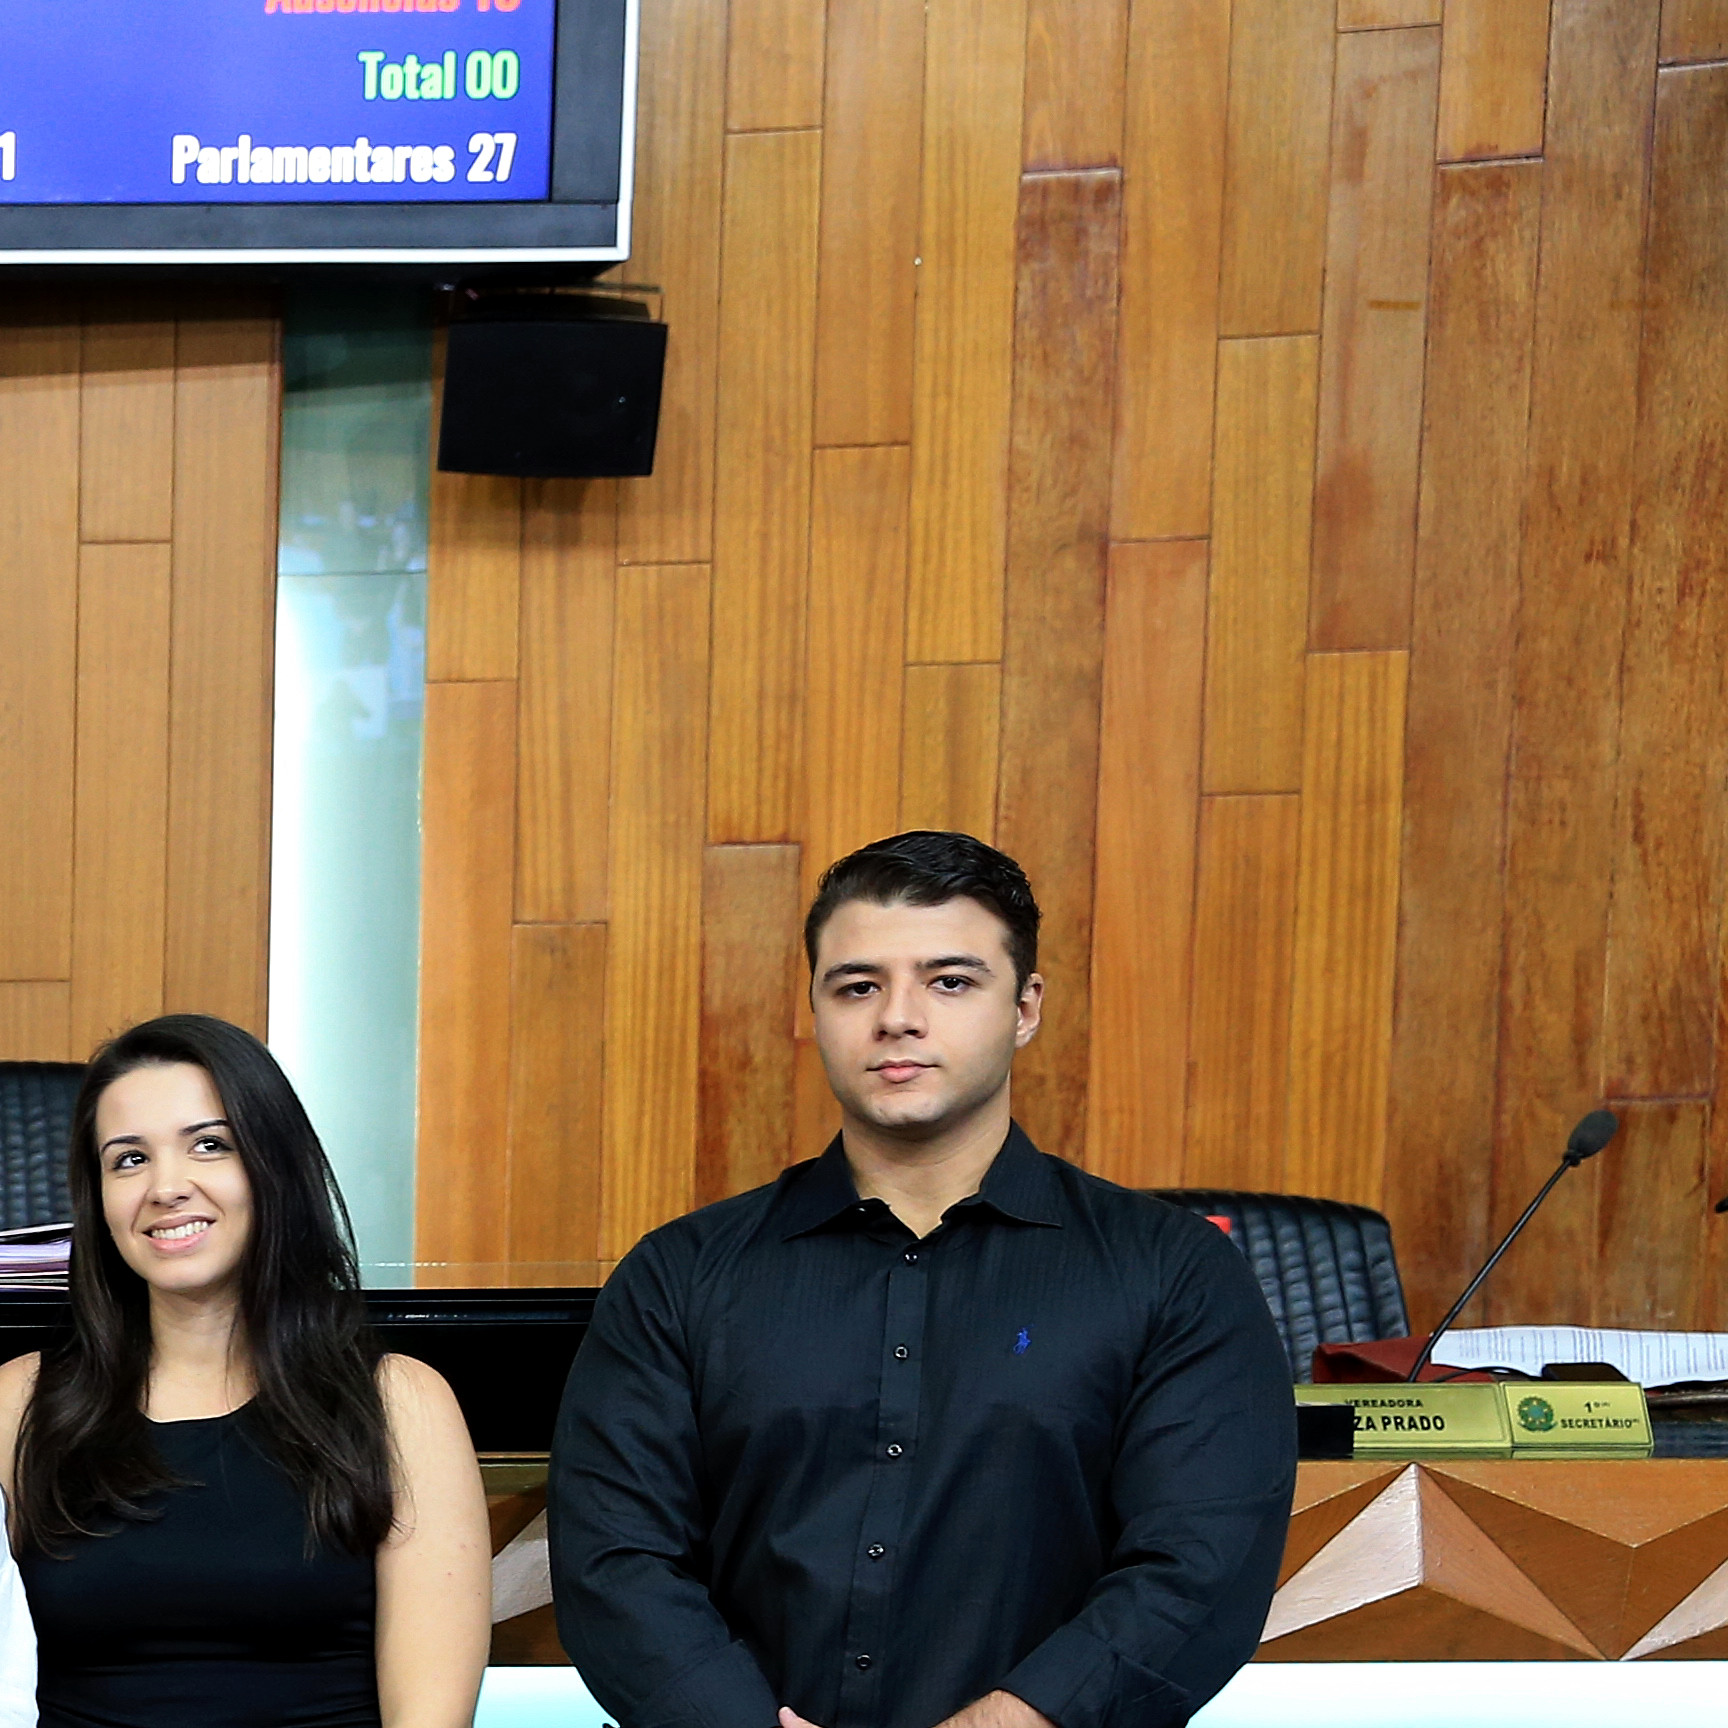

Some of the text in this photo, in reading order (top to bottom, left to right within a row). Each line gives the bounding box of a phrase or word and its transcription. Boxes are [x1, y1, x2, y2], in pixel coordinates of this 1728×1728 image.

[357, 49, 520, 101] Total 00
[170, 131, 519, 185] Parlamentares 27
[1353, 1415, 1446, 1432] ZA PRADO
